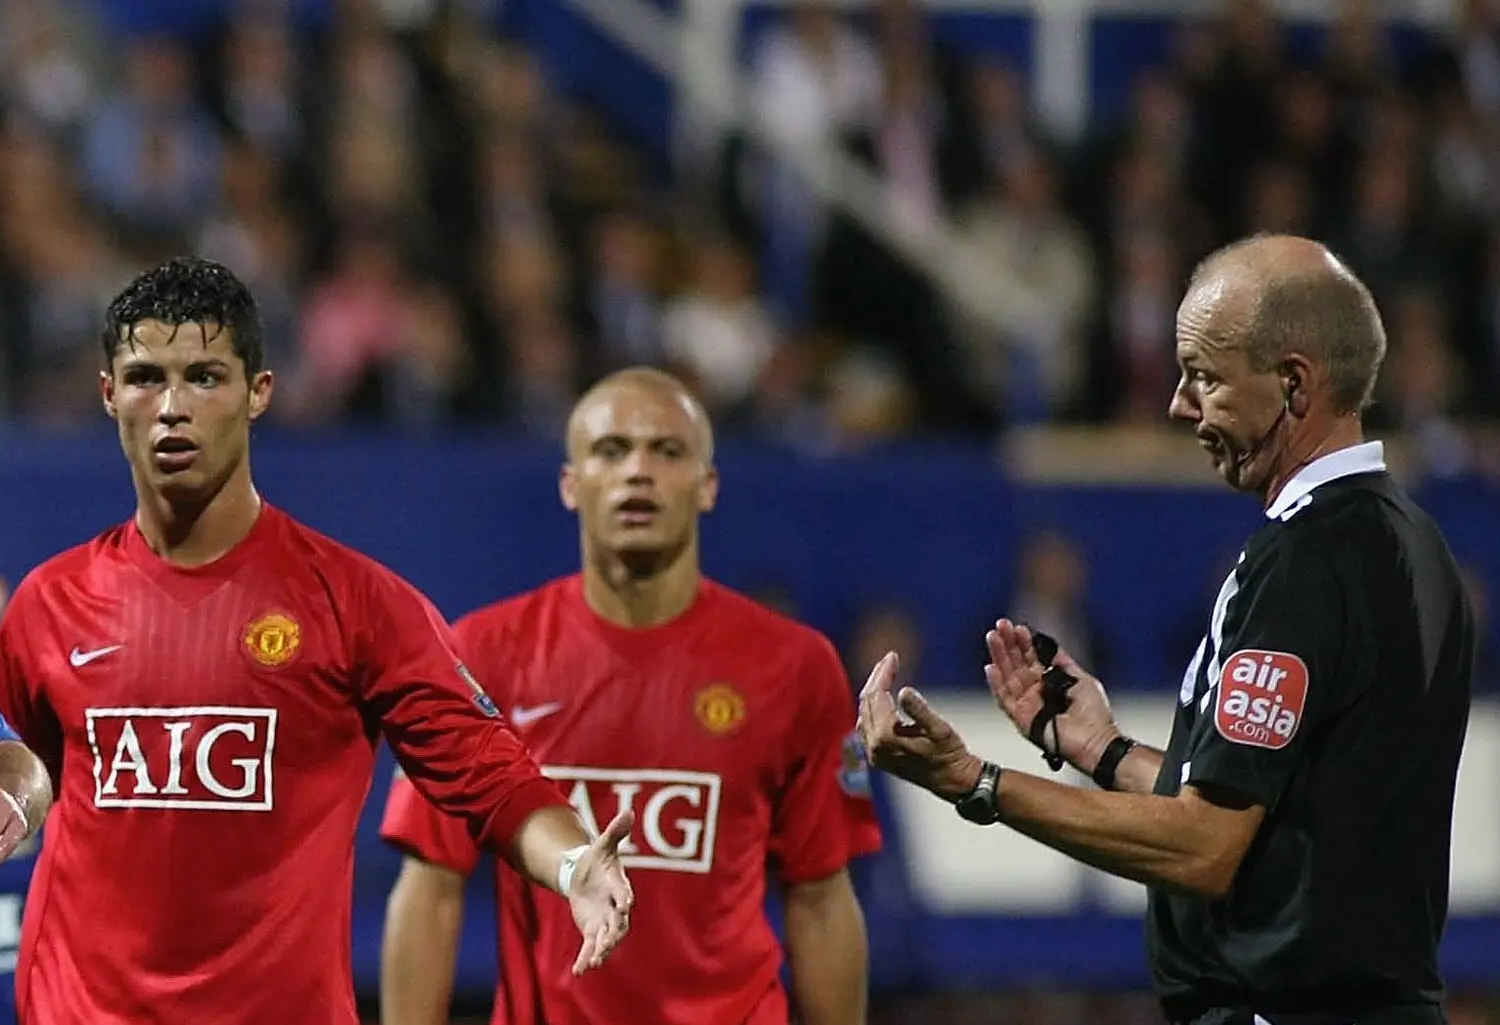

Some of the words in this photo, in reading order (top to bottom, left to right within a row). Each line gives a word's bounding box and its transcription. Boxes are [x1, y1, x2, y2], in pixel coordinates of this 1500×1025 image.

[1232, 655, 1288, 692] air
[1222, 690, 1296, 738] asia
[1229, 719, 1270, 743] .com
[102, 719, 260, 798] AIG
